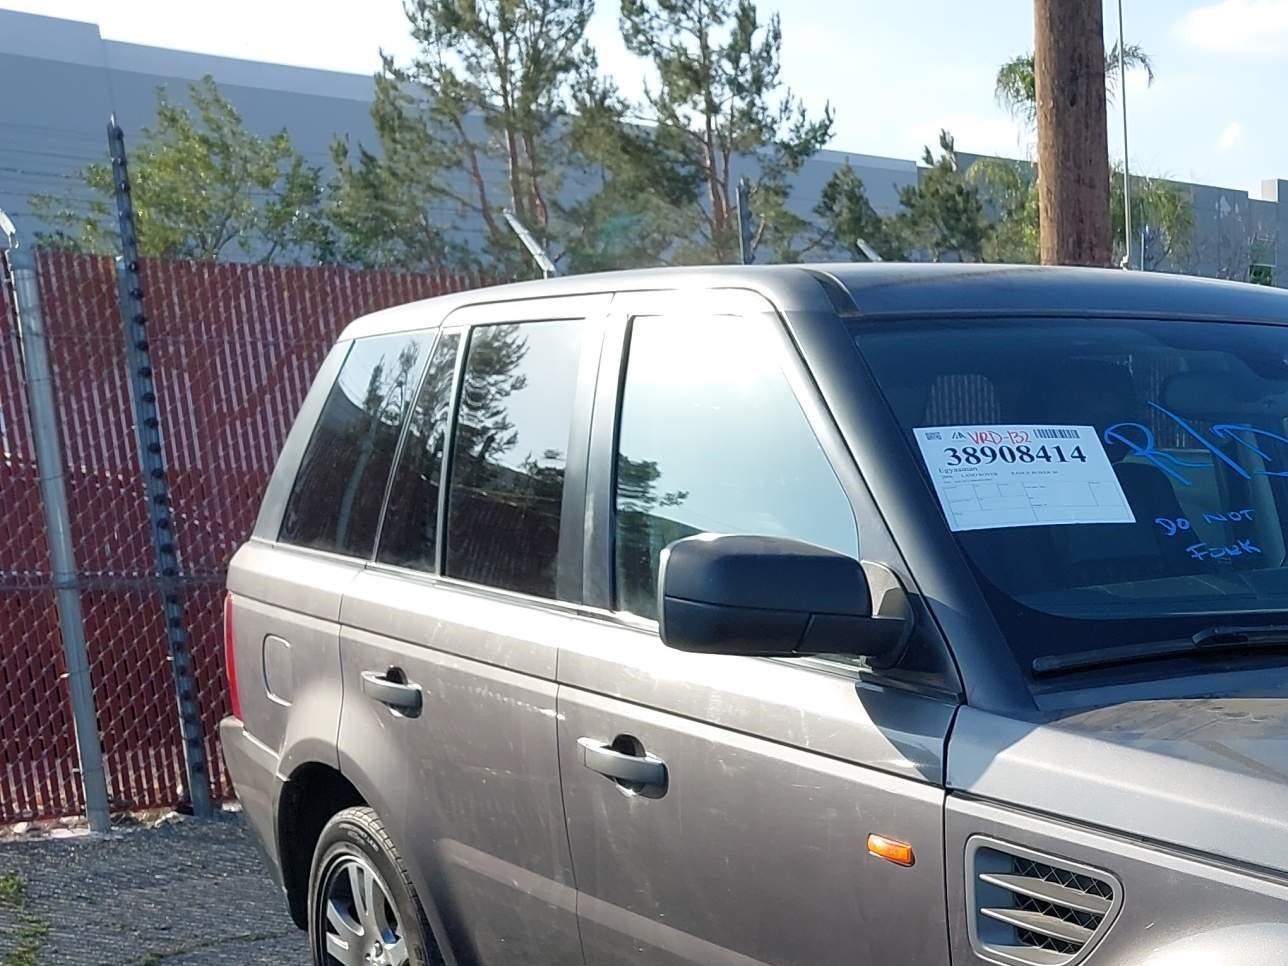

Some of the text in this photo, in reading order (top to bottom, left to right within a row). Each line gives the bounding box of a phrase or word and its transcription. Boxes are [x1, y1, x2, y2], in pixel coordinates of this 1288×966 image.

[944, 445, 1087, 466] 38908414
[1154, 508, 1256, 536] DO NOT
